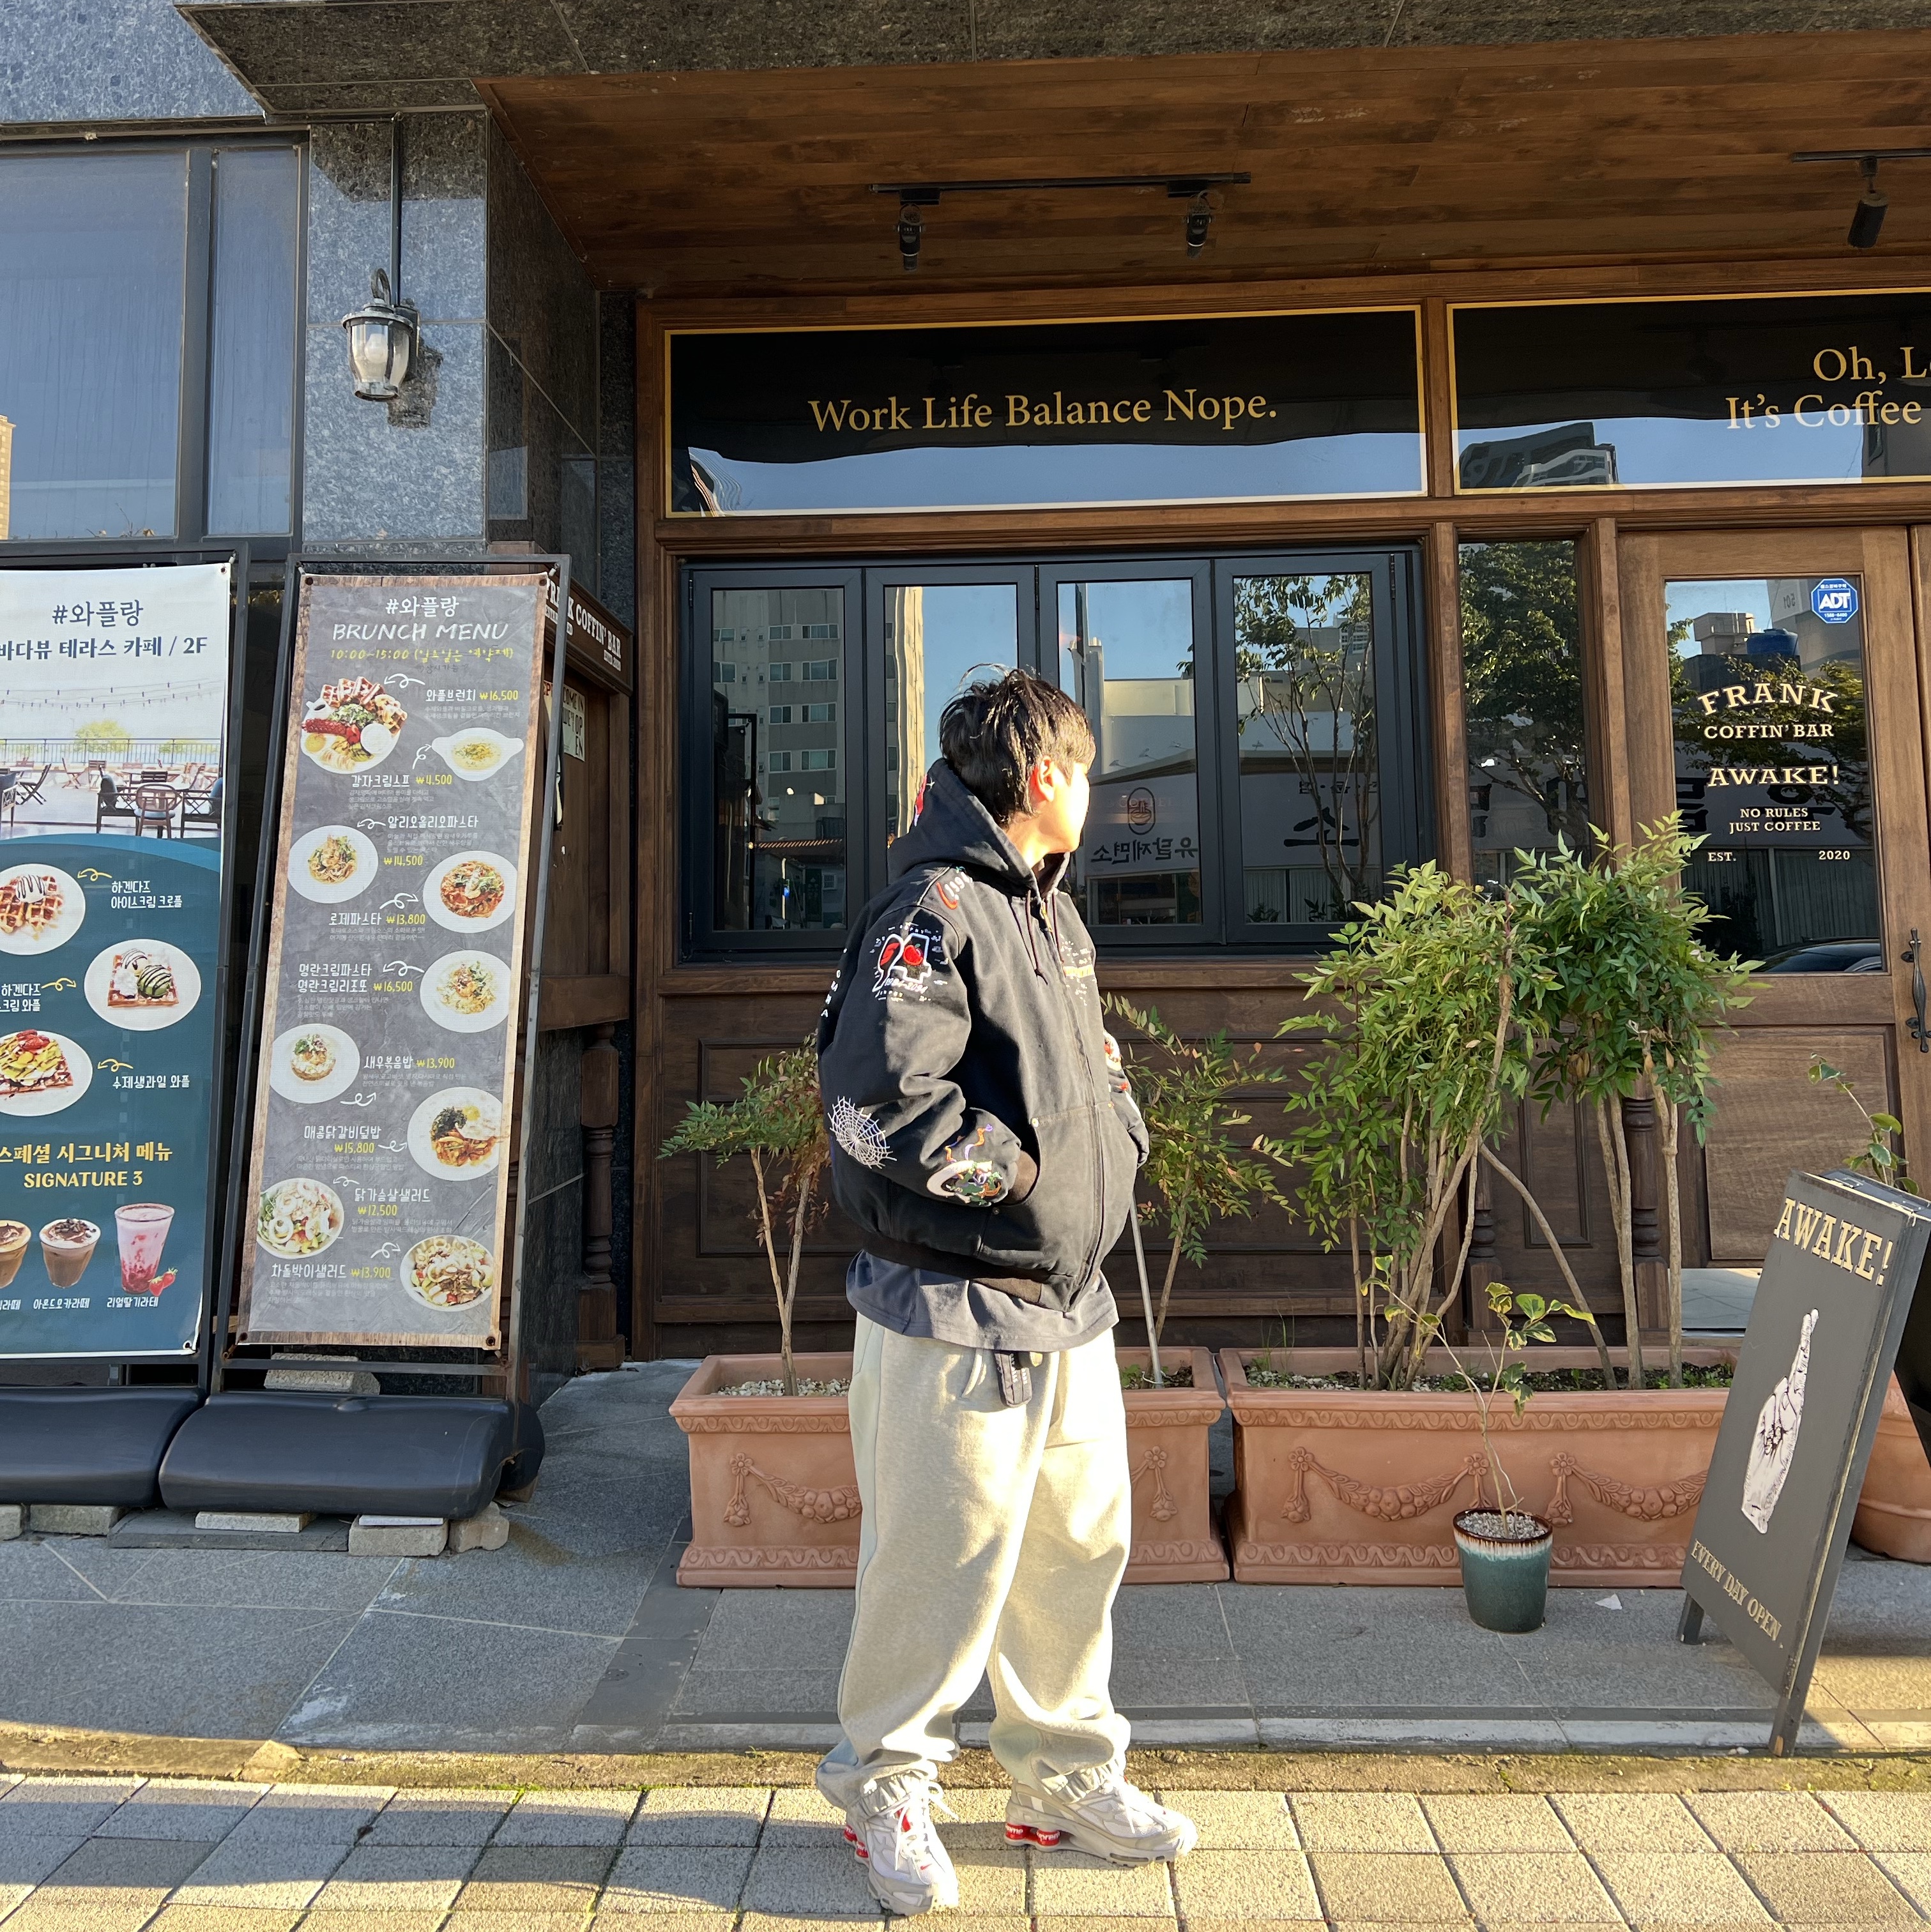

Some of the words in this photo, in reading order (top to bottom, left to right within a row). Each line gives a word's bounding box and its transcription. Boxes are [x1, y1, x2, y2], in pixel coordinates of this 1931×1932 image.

[1813, 346, 1886, 384] Oh,
[807, 396, 912, 432] Work
[922, 393, 992, 429] Life
[1005, 391, 1151, 427] Balance
[1163, 389, 1278, 430] Nope.
[1725, 393, 1781, 429] It's
[1794, 390, 1921, 427] Coffee
[385, 596, 459, 617] #와플랑
[1819, 592, 1851, 609] ADT
[52, 599, 143, 627] #와플랑
[333, 623, 427, 641] BRUNCH
[436, 623, 509, 641] MENU
[0, 640, 52, 660] 바다뷰
[59, 639, 116, 658] 테라스
[124, 637, 161, 657] 카페
[183, 637, 208, 654] 2F
[607, 630, 622, 659] BAR
[426, 689, 477, 703] 와플브런치
[1698, 683, 1838, 715] FRANK
[1793, 724, 1834, 737] BAR
[352, 775, 410, 787] 감자크림스프
[1707, 765, 1839, 787] AWAKE!
[1740, 809, 1760, 818] NO
[1765, 808, 1808, 818] RULES
[388, 815, 479, 828] 알리오올리오파스타
[1729, 822, 1759, 834] JUST
[1764, 821, 1820, 831] COFFEE
[1707, 852, 1736, 862] EST.
[1819, 850, 1850, 860] 2020
[112, 880, 151, 894] 하겐다즈
[111, 896, 156, 909] 아이스크림
[158, 895, 183, 908] 크로플
[328, 912, 382, 925] 로제파스타
[299, 963, 372, 977] 명란크림파스타
[1, 984, 42, 996] 하겐다즈
[298, 980, 368, 993] 명란크림리조또
[22, 998, 41, 1012] 와플
[363, 1055, 413, 1069] 새우볶음밥
[112, 1075, 166, 1089] 수제생과일
[170, 1074, 190, 1088] 와플
[0, 1144, 50, 1164] 스페셜
[57, 1142, 130, 1163] 시그니처
[136, 1141, 173, 1161] 메뉴
[24, 1171, 128, 1188] SIGNATURE
[133, 1170, 143, 1186] 3
[355, 1188, 431, 1203] 닭가슴살샐러드
[1773, 1196, 1894, 1286] AWAKE!
[271, 1263, 347, 1278] 차돌박이샐러드
[1691, 1538, 1727, 1583] EVERY
[1723, 1571, 1750, 1606] DAY
[1747, 1597, 1782, 1641] OPEN
